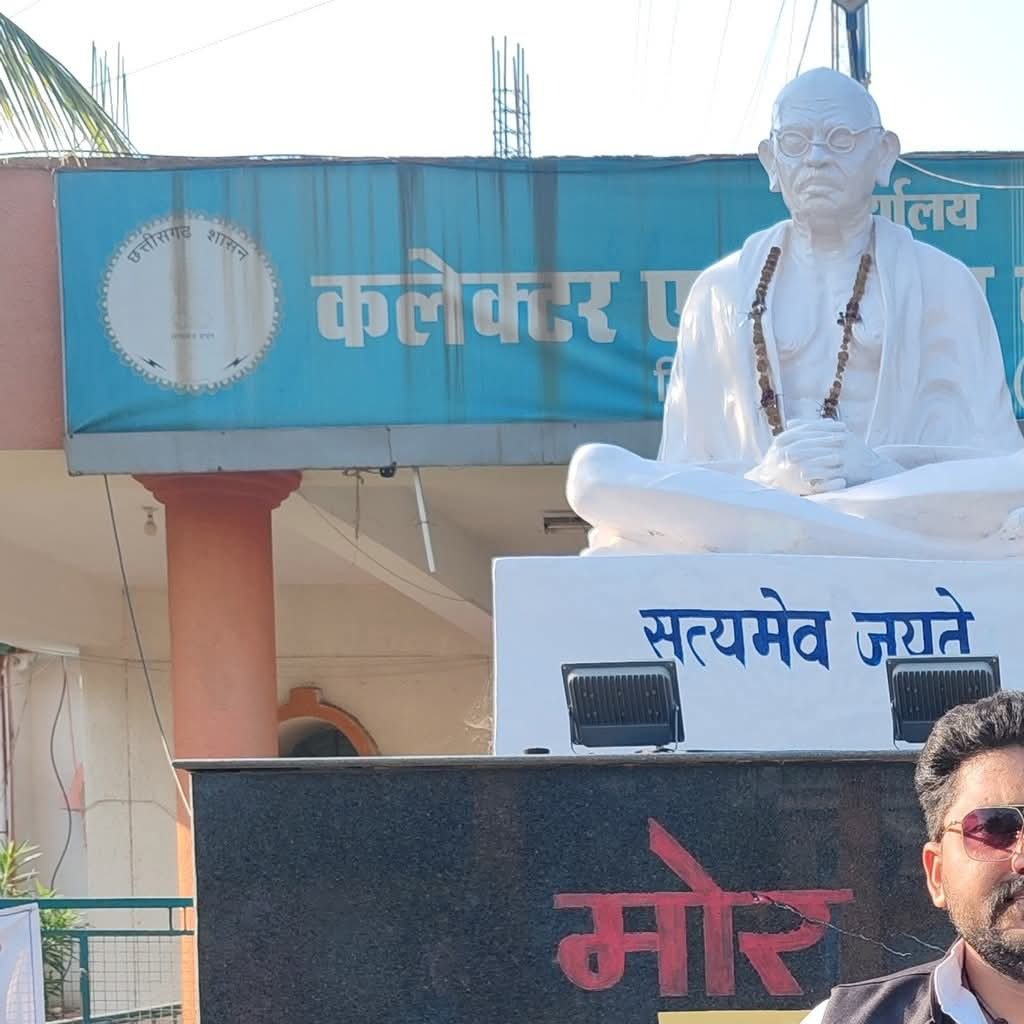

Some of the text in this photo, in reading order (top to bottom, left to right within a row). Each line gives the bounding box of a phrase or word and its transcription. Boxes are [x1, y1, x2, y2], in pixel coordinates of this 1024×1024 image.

[207, 229, 249, 261] शासन
[310, 248, 621, 347] कलेक्टर
[638, 586, 976, 670] सत्यमेव जयते
[553, 817, 856, 997] मोर
